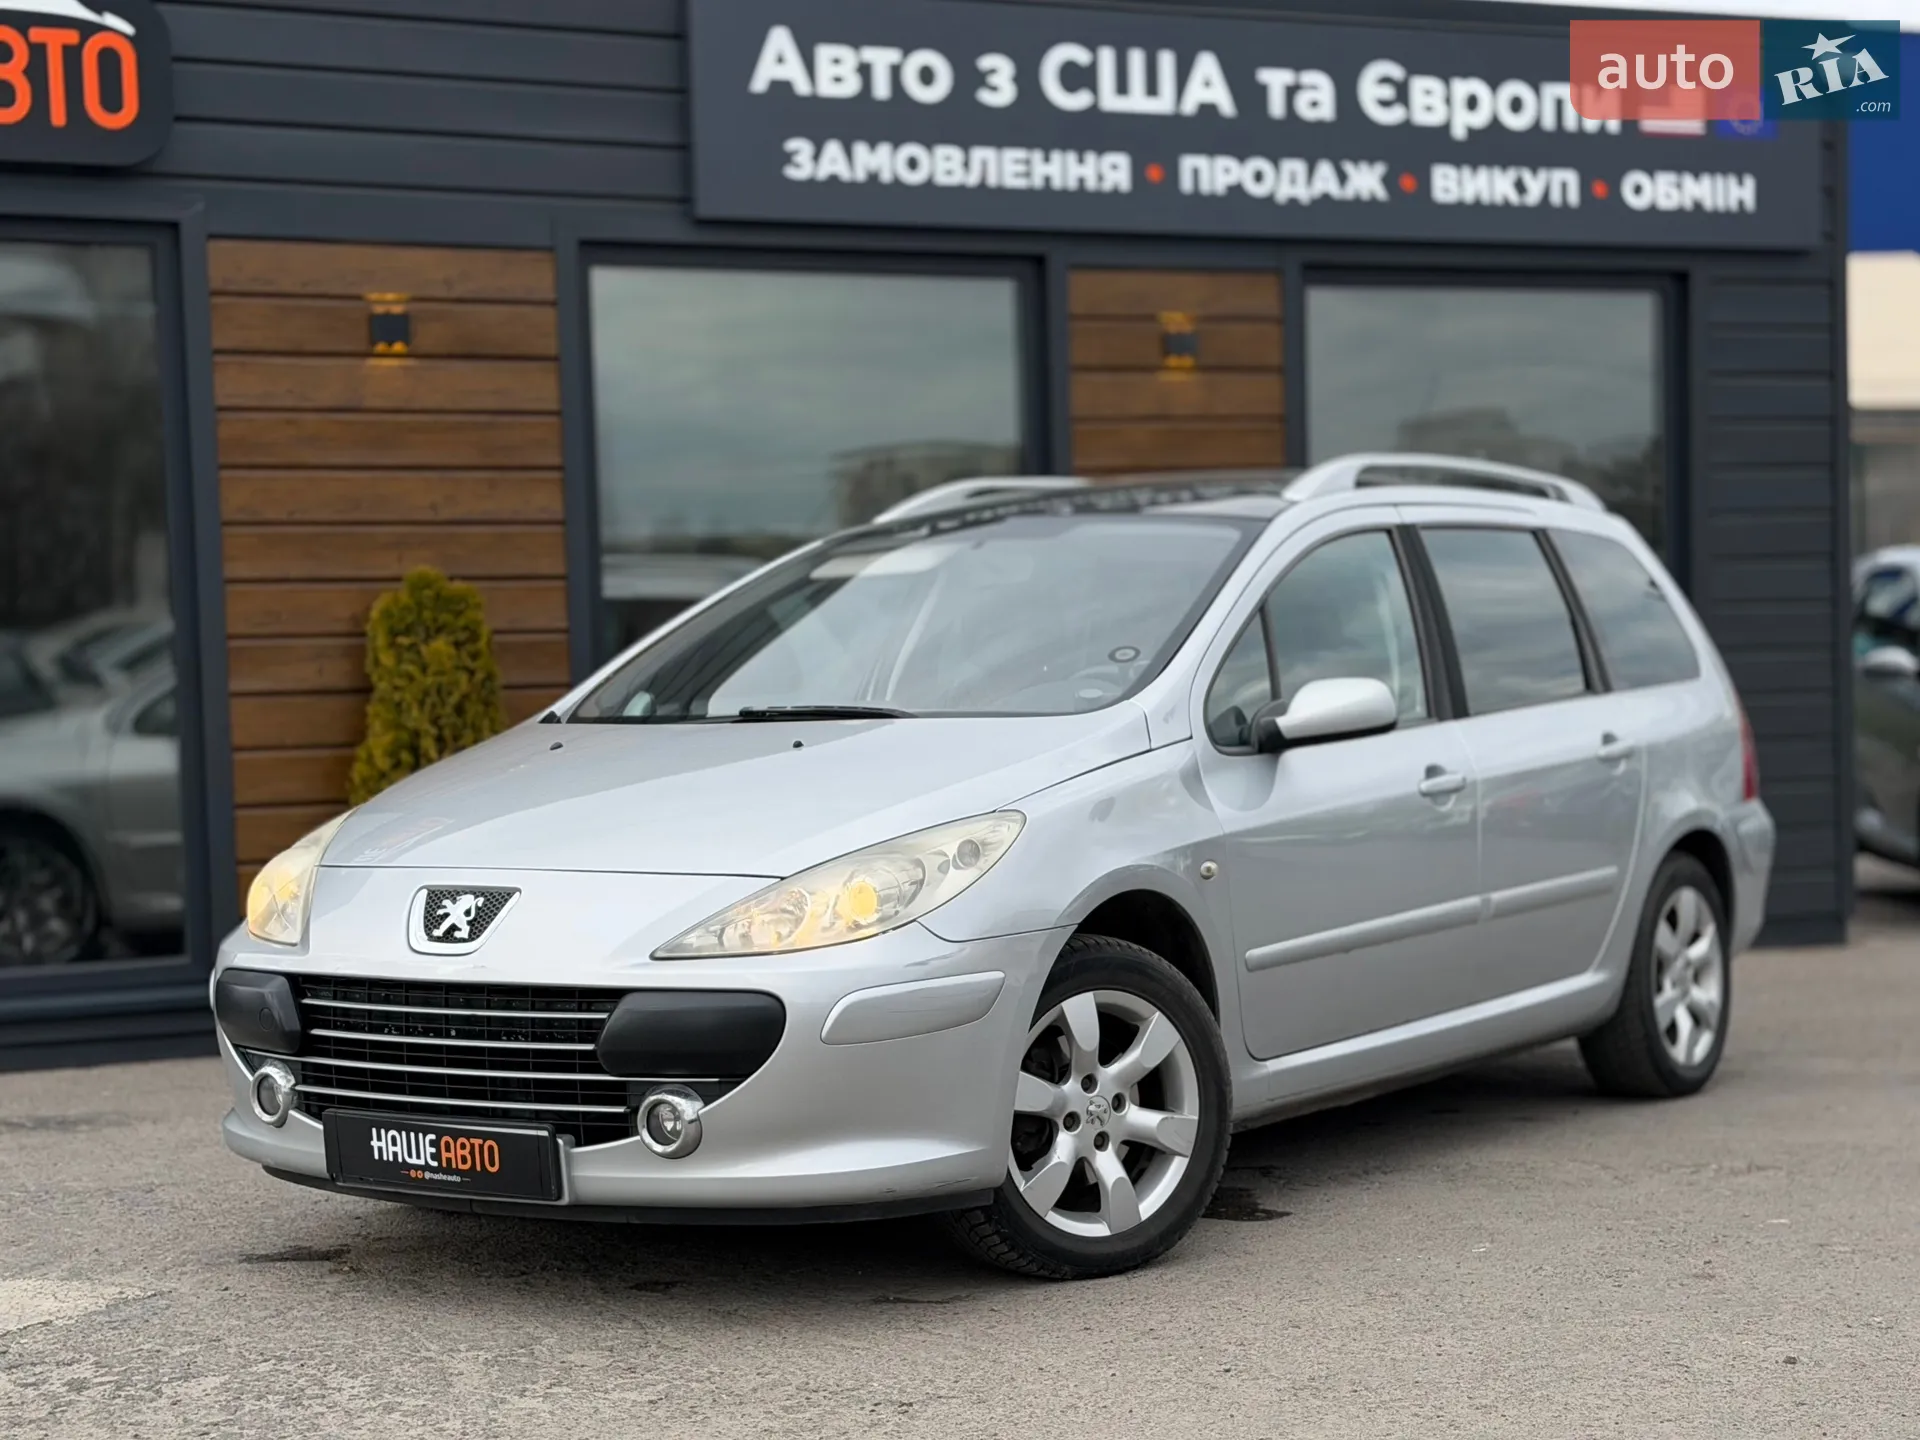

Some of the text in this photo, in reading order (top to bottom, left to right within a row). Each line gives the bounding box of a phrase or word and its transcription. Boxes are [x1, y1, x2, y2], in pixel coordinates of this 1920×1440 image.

[749, 25, 955, 104] Авто
[975, 53, 1018, 108] з
[1039, 42, 1238, 118] США
[1255, 67, 1336, 122] та
[783, 137, 1757, 213] ЗАМОВЛЕННЯ ПРОДАЖ ВИКУП ОБМІН
